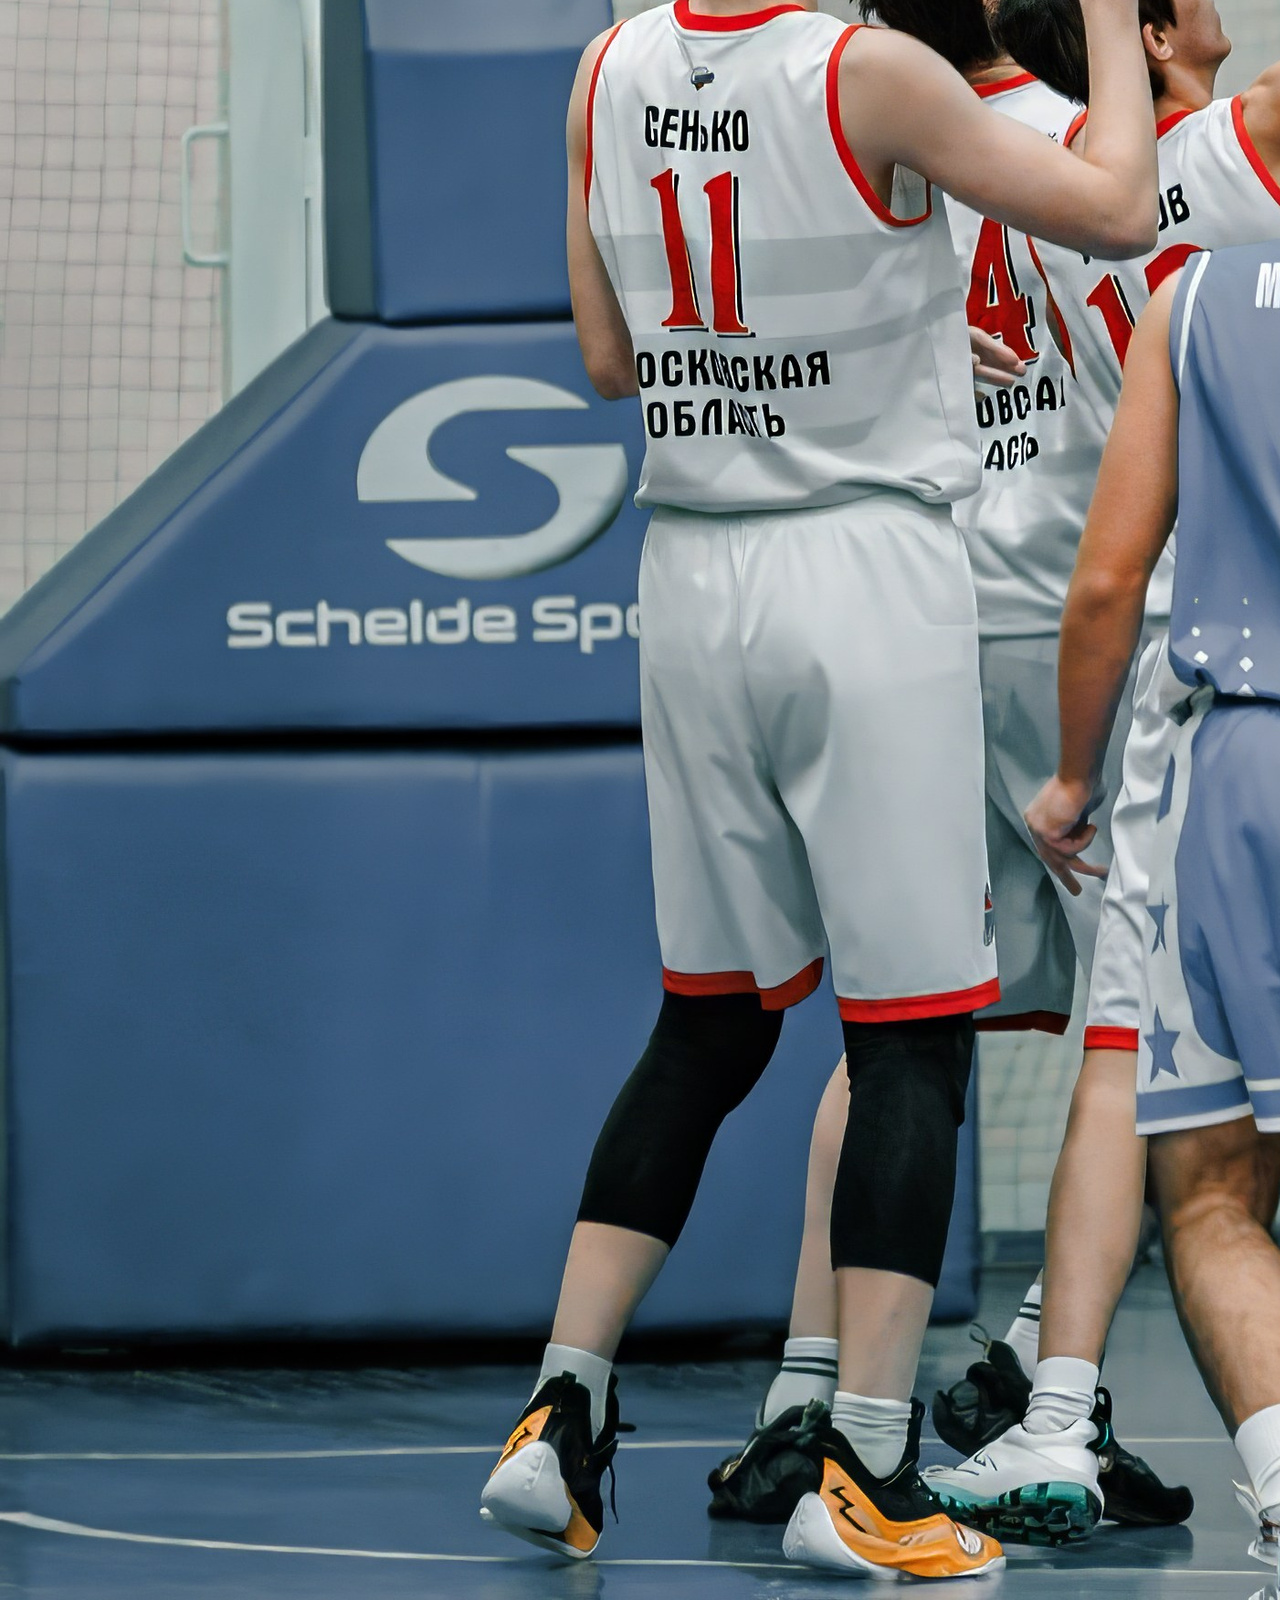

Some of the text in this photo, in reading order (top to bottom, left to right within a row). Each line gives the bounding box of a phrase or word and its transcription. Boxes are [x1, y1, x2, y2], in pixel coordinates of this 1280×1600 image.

[644, 105, 750, 152] СЕНЬКО
[650, 168, 757, 338] 11
[636, 348, 831, 393] ОСКОВСКАЯ
[226, 598, 517, 649] Schelde
